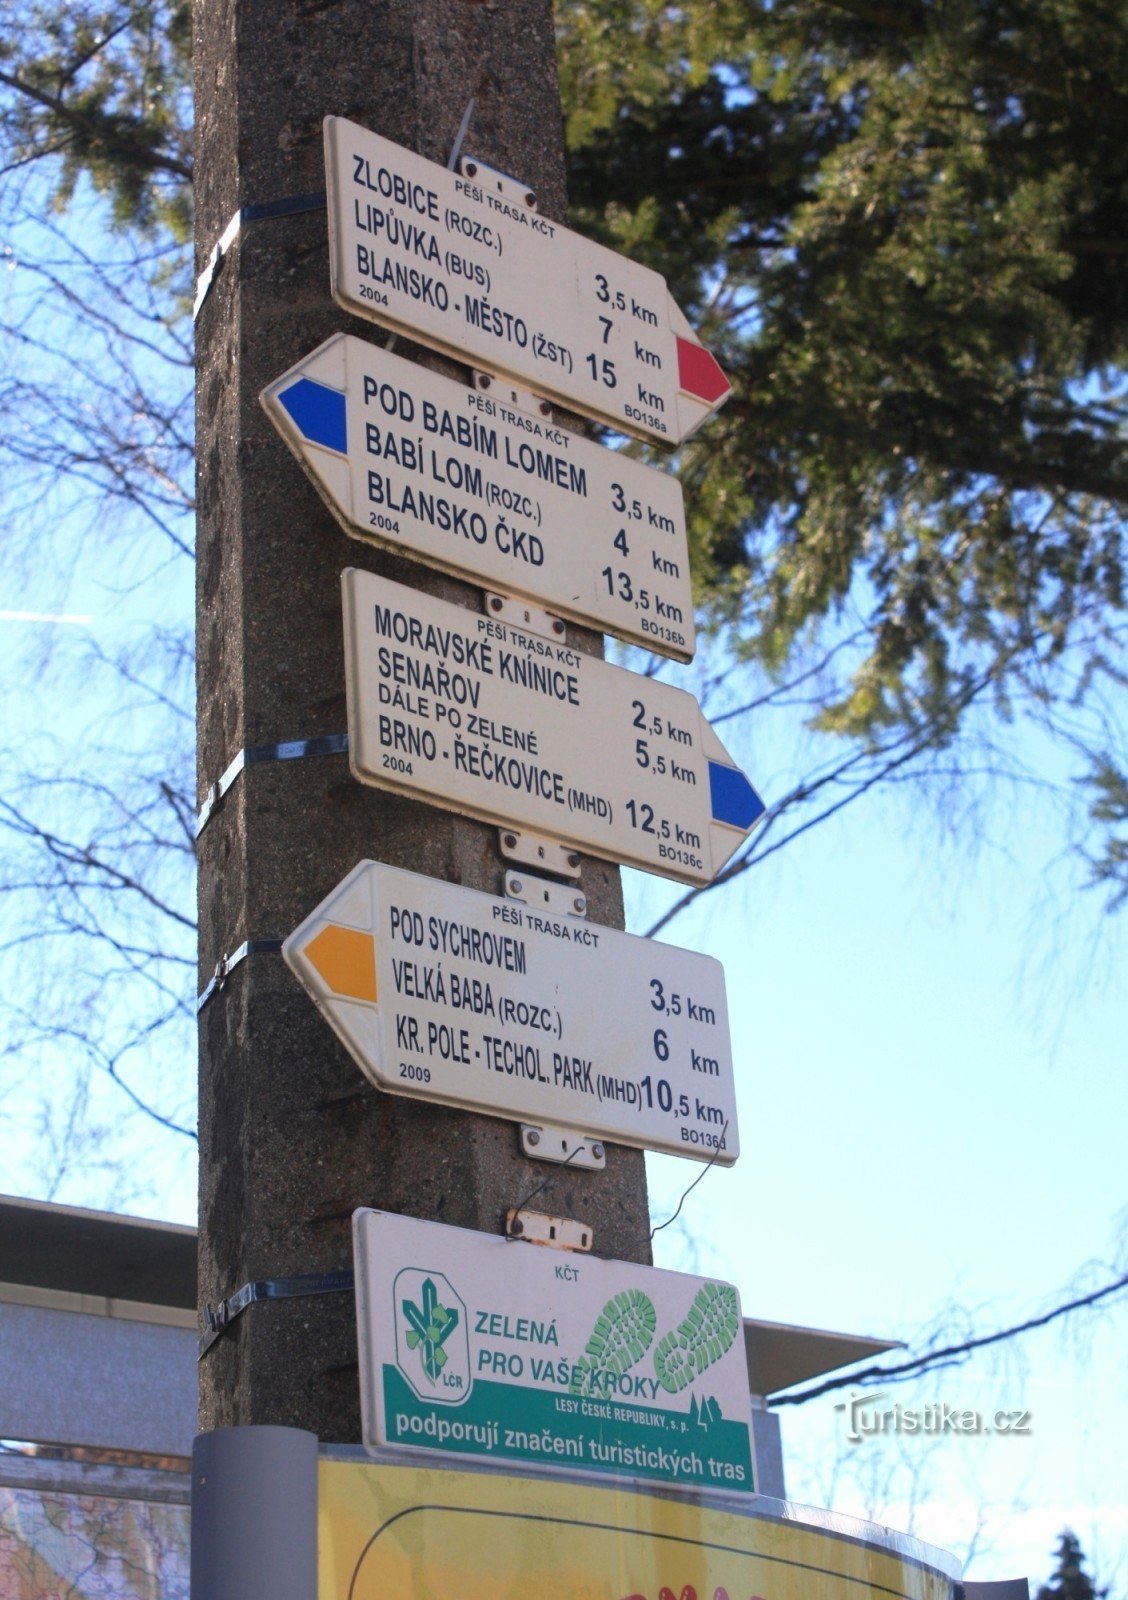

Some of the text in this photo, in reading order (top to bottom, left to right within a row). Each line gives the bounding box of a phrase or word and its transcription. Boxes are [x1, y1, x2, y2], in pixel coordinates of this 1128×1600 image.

[353, 155, 502, 256] ZLOBICE (ROZC.)
[455, 180, 555, 238] PĚŠÍ TRASA KČT
[355, 199, 491, 293] LIPŮVKA (BUS)
[357, 244, 448, 311] BLANSKO
[465, 294, 527, 348] MĚSTO
[532, 334, 573, 373] (ŽST)
[359, 285, 388, 306] 2004
[595, 275, 657, 327] 3,5 km
[598, 317, 661, 369] 7 km
[586, 353, 664, 412] 15 km
[363, 375, 587, 497] POD BABÍM LOMEM
[468, 395, 569, 449] PĚŠÍ TRASA KČT
[624, 403, 666, 433] BO136a
[366, 423, 424, 474] BABÍ
[368, 471, 544, 566] BLANSKO ČKD
[369, 512, 399, 534] 2004
[610, 483, 675, 534] 3,5 km
[614, 529, 679, 579] 4 km
[601, 566, 683, 623] 13,5 km
[375, 604, 580, 706] MORAVSKÉ KNÍNICE
[477, 620, 581, 669] PĚŠÍ TRASA KČT
[641, 618, 685, 646] BO136b
[378, 647, 480, 708] SENAŘOV
[379, 683, 538, 755] DÁLE PO ZELENÉ
[632, 701, 693, 746] 2,5 km
[379, 715, 436, 761] BRNO
[455, 734, 565, 804] ŘEČKOVICE
[382, 754, 413, 776] 2004
[635, 740, 696, 785] 5,5 km
[625, 800, 700, 849] 12,5 km
[658, 844, 703, 869] BO136c
[390, 905, 526, 975] POD SYCHROVEM
[492, 905, 599, 949] PĚŠÍ TRASA KČT
[392, 958, 562, 1040] VELKÁ BABA (ROZC.)
[650, 979, 715, 1025] 3,5 km
[396, 1013, 424, 1054] KR.
[429, 1022, 469, 1065] POLE
[483, 1034, 550, 1084] TECHOL.
[553, 1052, 594, 1094] PARK
[400, 1063, 431, 1083] 2009
[653, 1029, 719, 1076] 6 km
[641, 1076, 724, 1125] 10,5 km
[681, 1127, 726, 1150] BO136d
[555, 1265, 579, 1283] KČT
[475, 1312, 559, 1347] ZELENÁ
[443, 1371, 463, 1389] LČR
[478, 1350, 660, 1399] PRO VAŠE KROKY
[555, 1398, 578, 1414] LESY
[582, 1400, 611, 1419] ČESKÉ
[614, 1408, 668, 1430] REPUBLIKY,
[396, 1412, 745, 1480] podporují značení turistických tras
